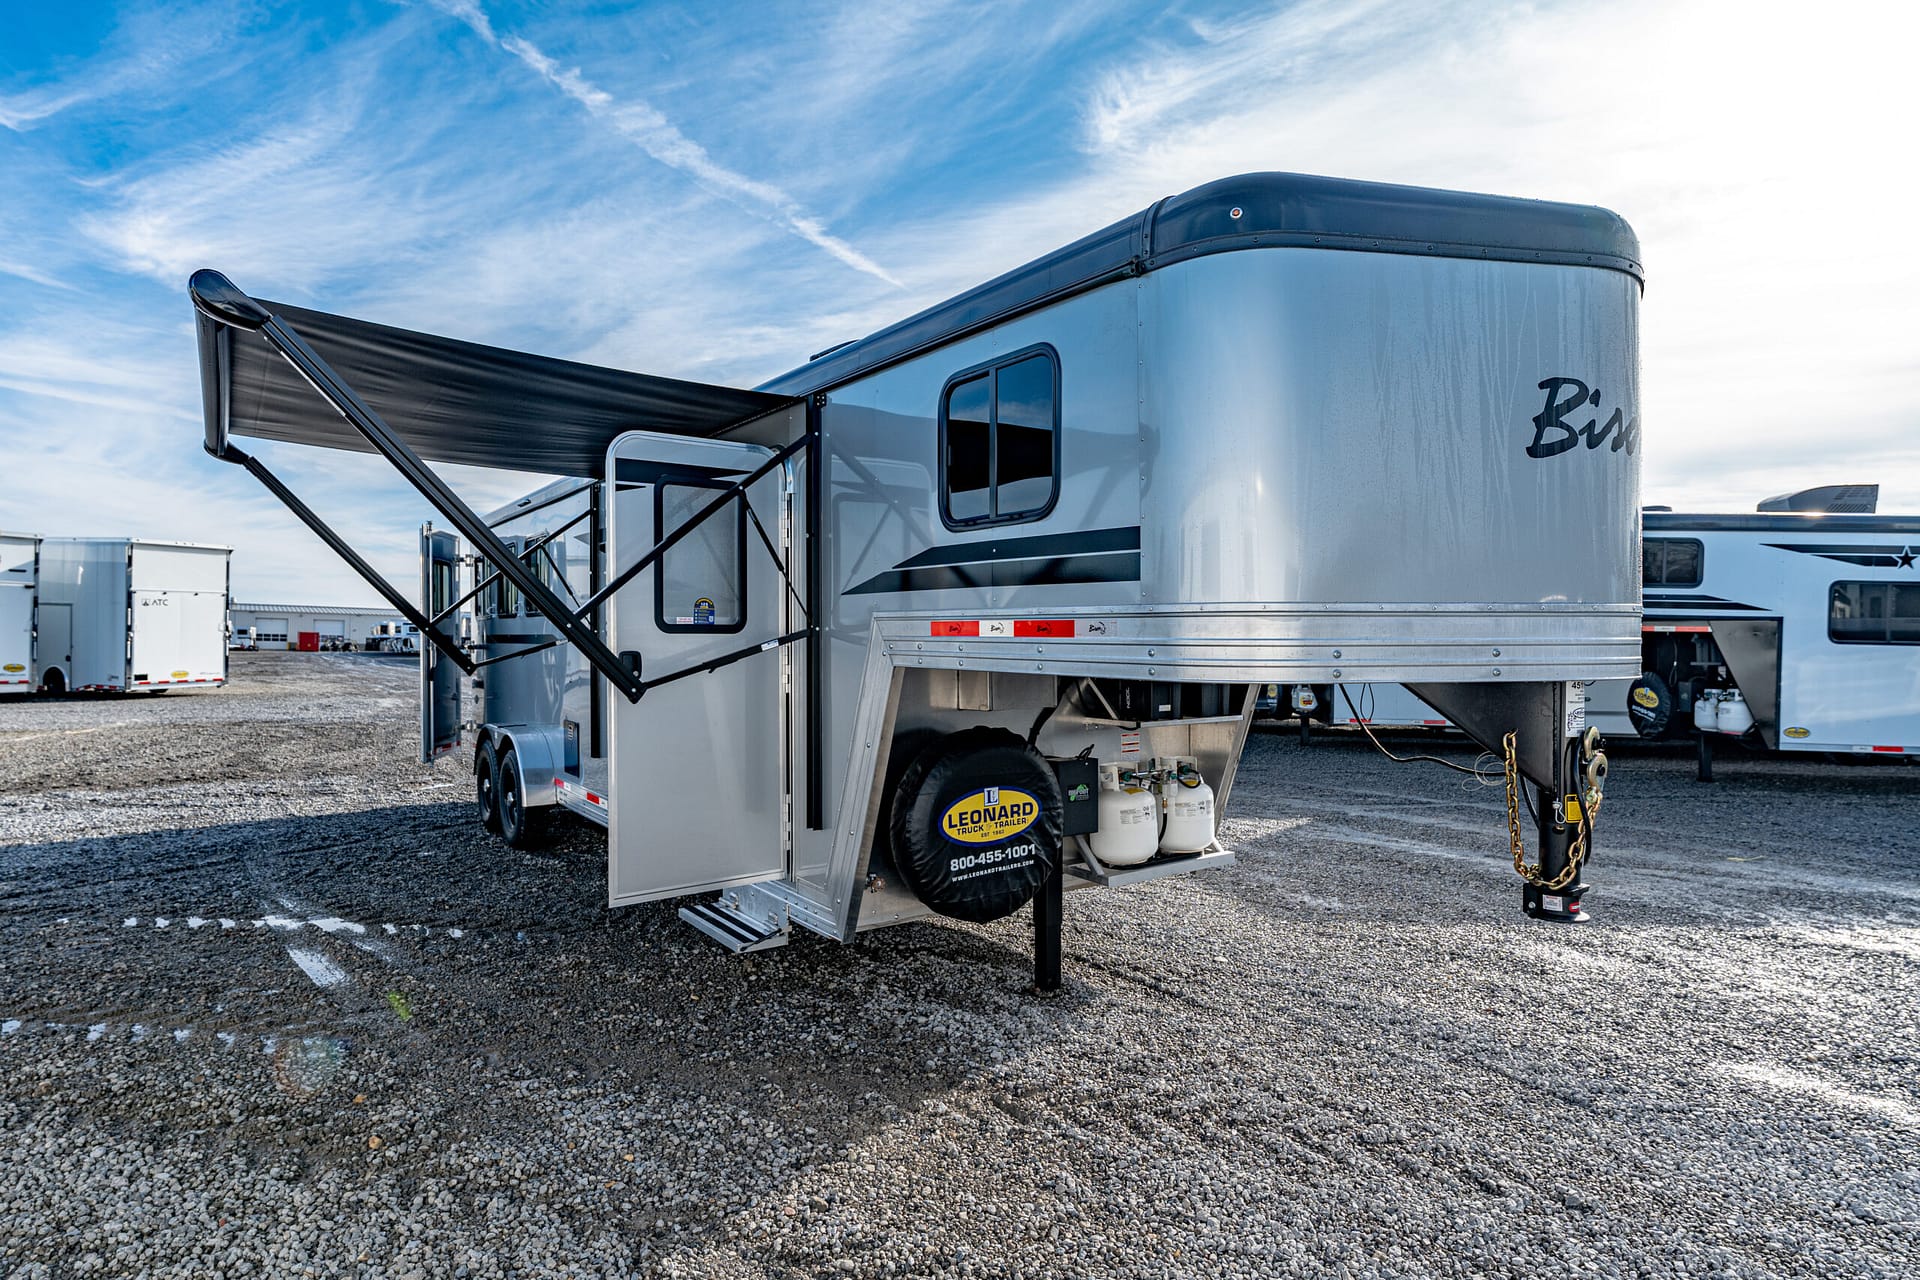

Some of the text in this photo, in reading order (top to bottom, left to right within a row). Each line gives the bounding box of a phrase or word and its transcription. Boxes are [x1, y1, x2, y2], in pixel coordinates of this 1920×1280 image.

[947, 802, 1034, 829] LEONARD
[956, 824, 984, 836] TRUCK
[994, 817, 1027, 829] TRAILER
[950, 843, 1036, 872] 800-455-1001
[951, 859, 1035, 882] WWW.LEONARDTRAILERS.COM
